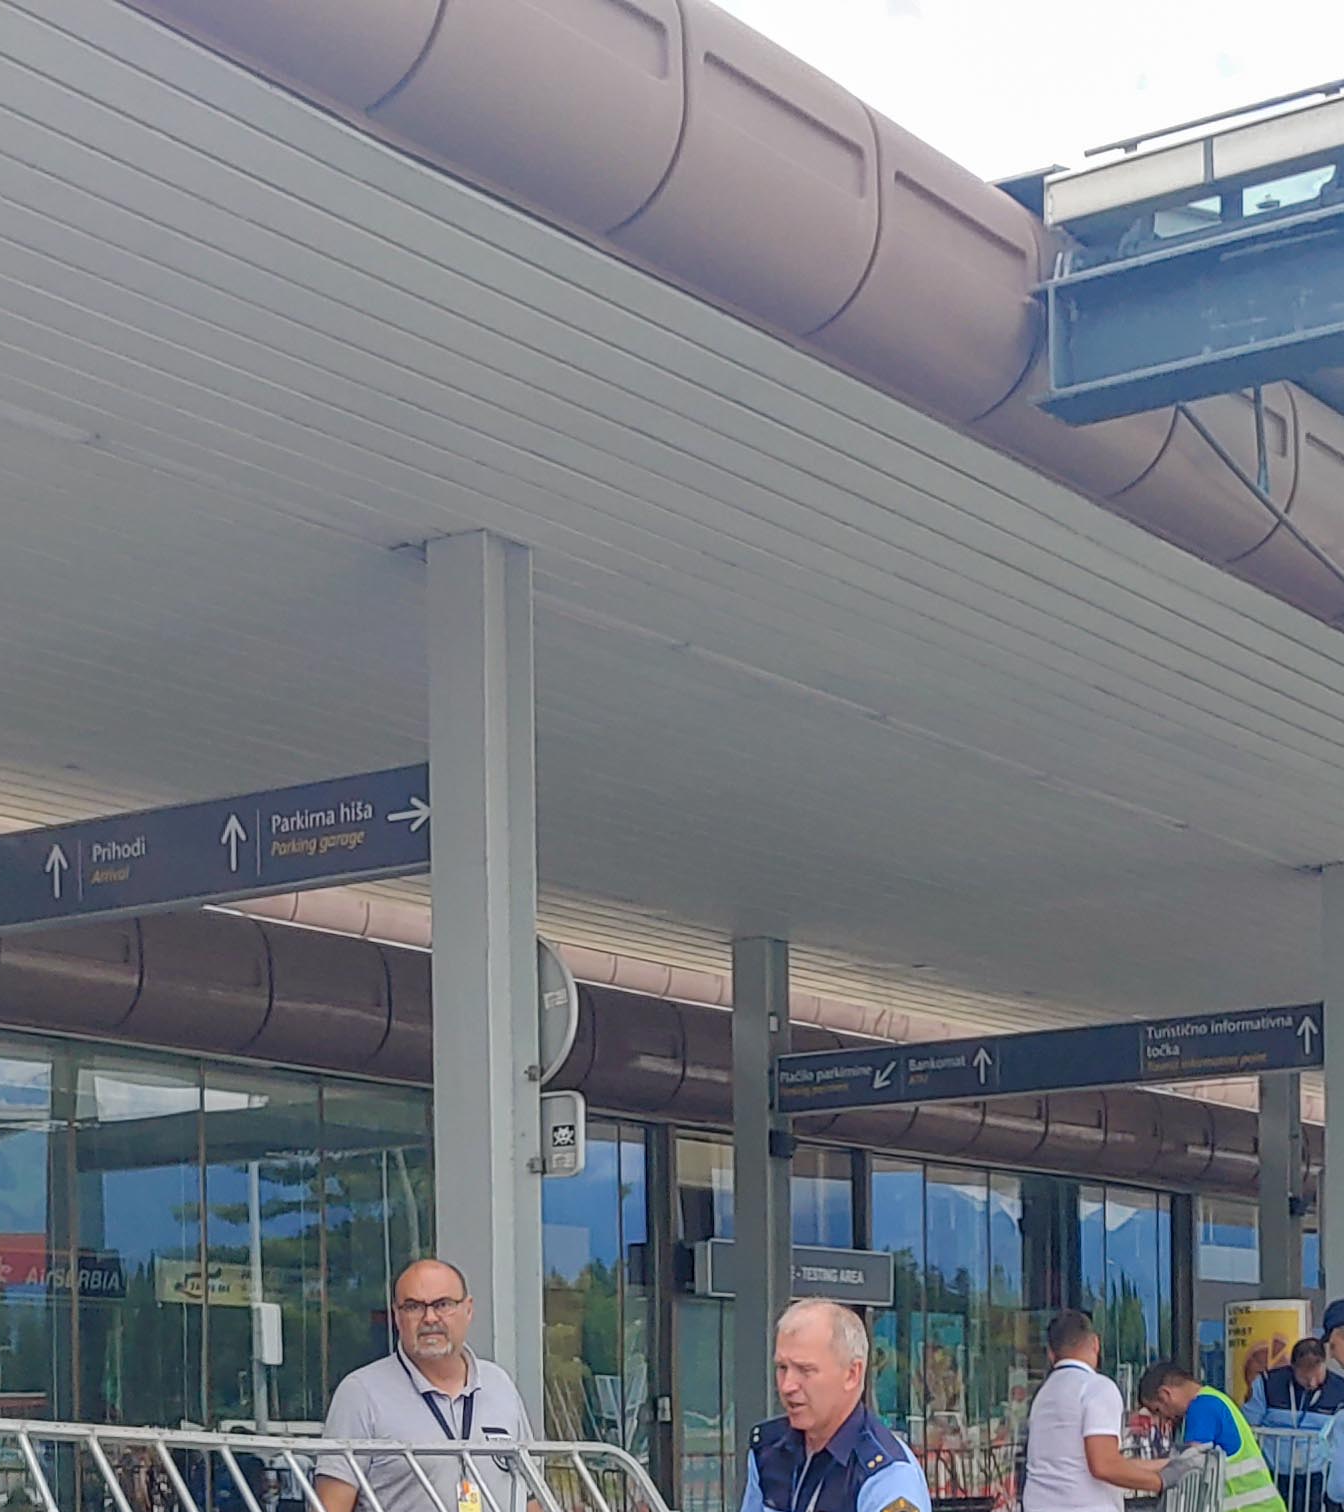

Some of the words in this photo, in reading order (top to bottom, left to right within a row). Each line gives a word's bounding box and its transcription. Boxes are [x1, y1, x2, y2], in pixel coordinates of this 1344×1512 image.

[271, 808, 334, 835] Parkirna
[340, 800, 374, 822] hiša
[91, 835, 146, 863] Prihodi
[908, 1055, 966, 1072] Bankomat
